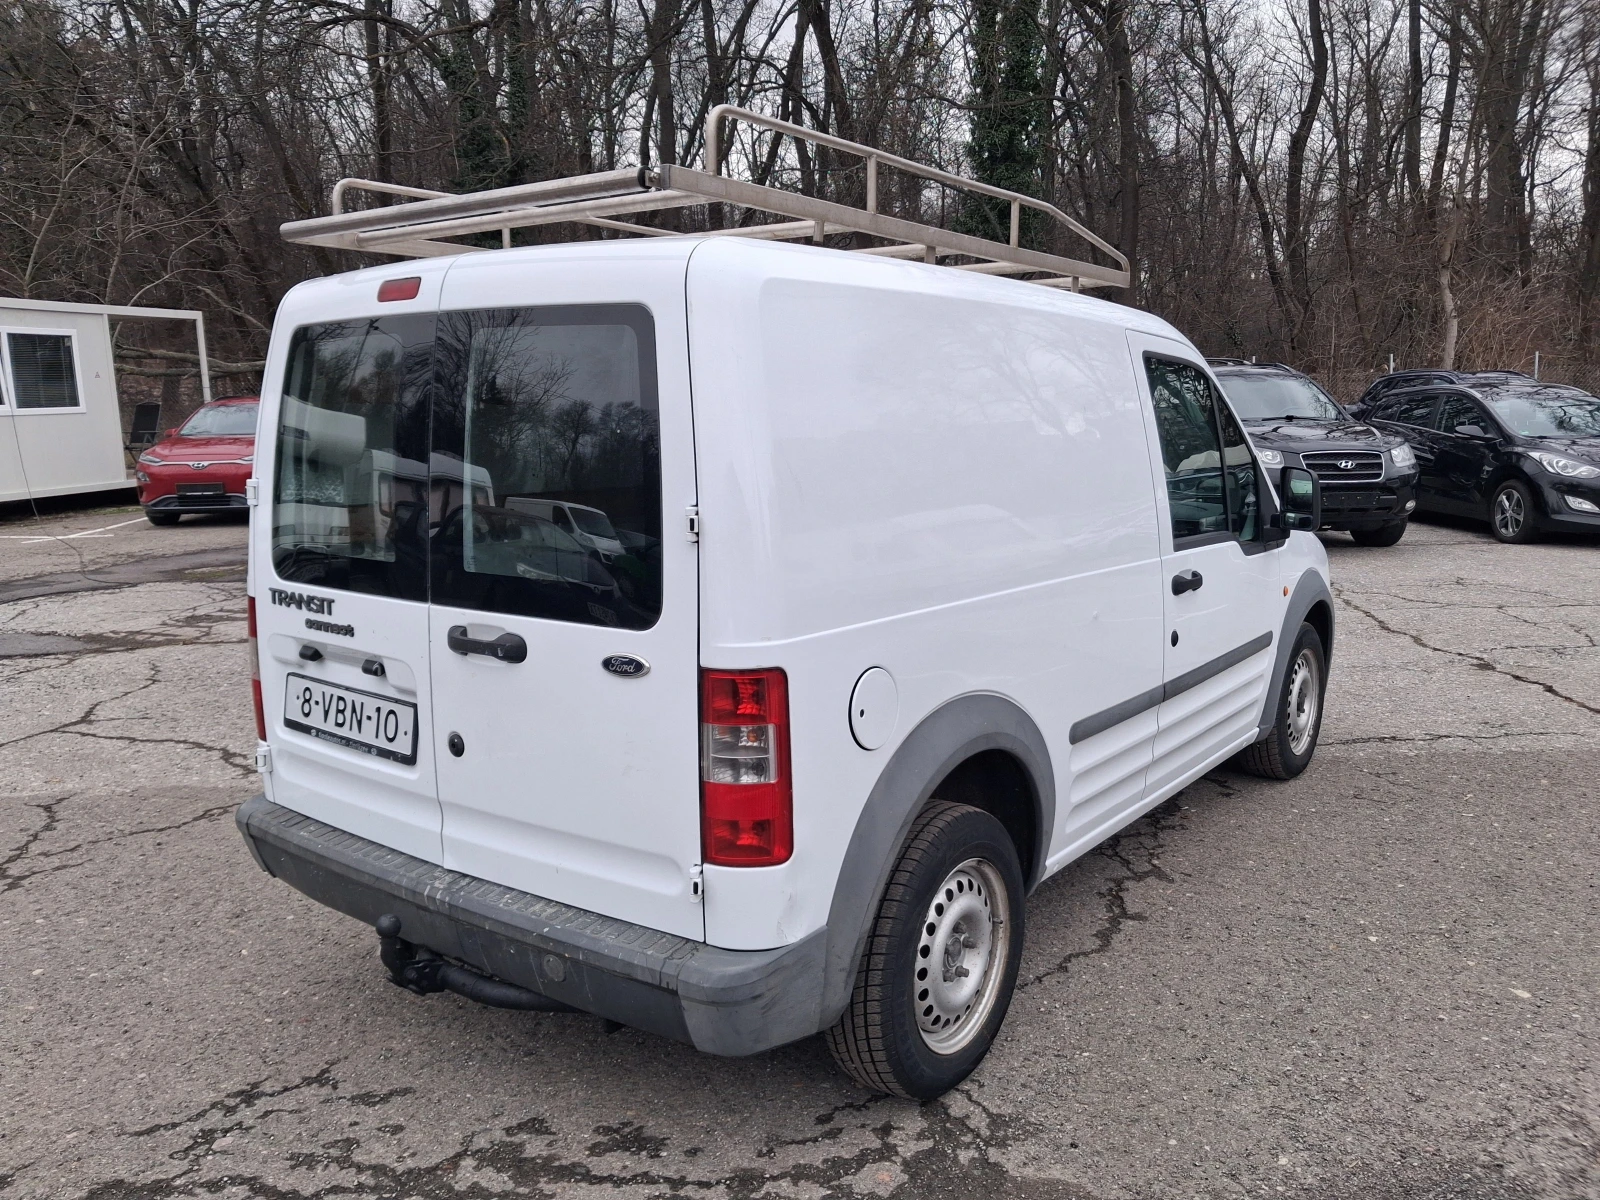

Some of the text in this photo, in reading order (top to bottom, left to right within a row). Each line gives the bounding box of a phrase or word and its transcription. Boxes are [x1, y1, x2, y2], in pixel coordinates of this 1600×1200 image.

[269, 587, 335, 616] TRANSIT
[305, 617, 355, 638] connect
[608, 657, 636, 673] Ford
[301, 686, 399, 743] 8-VBN-10
